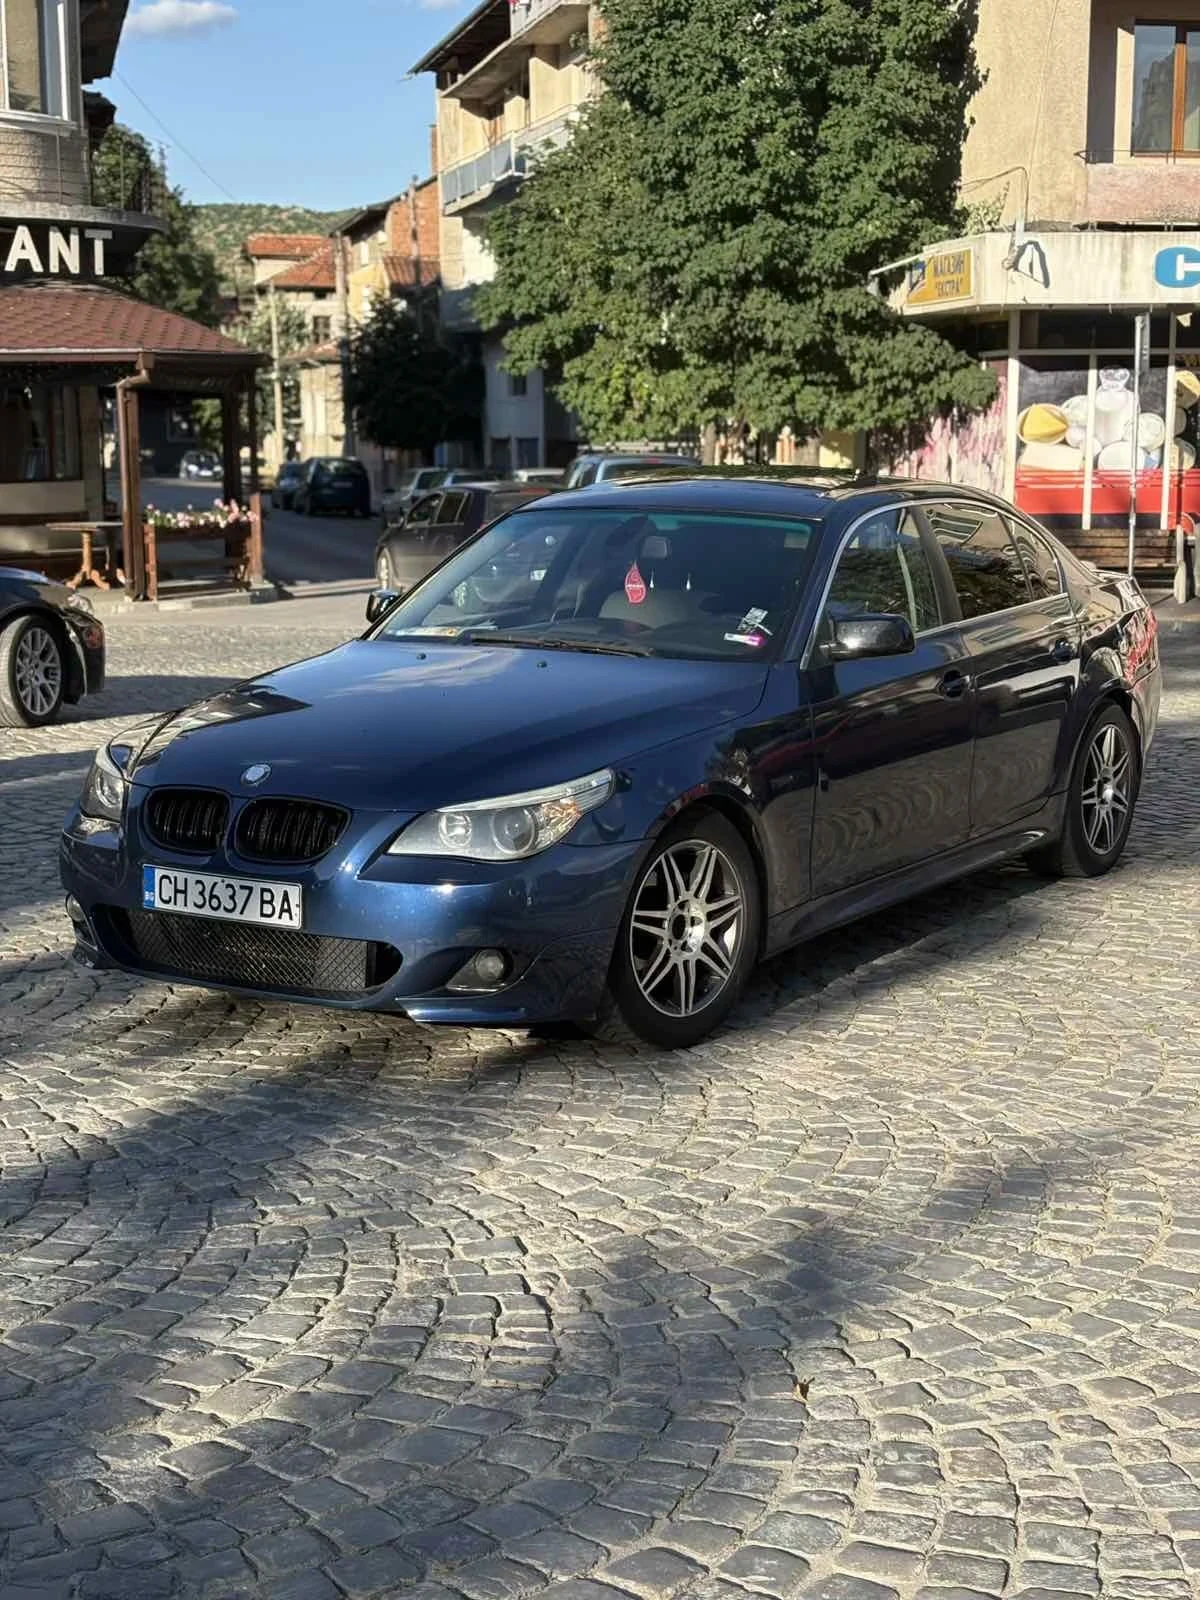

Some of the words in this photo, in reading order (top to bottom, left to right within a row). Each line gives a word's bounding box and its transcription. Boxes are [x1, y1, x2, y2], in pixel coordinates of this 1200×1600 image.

[4, 225, 113, 276] ANT
[158, 874, 188, 907] CH
[193, 879, 253, 915] 3637
[259, 887, 293, 921] BA
